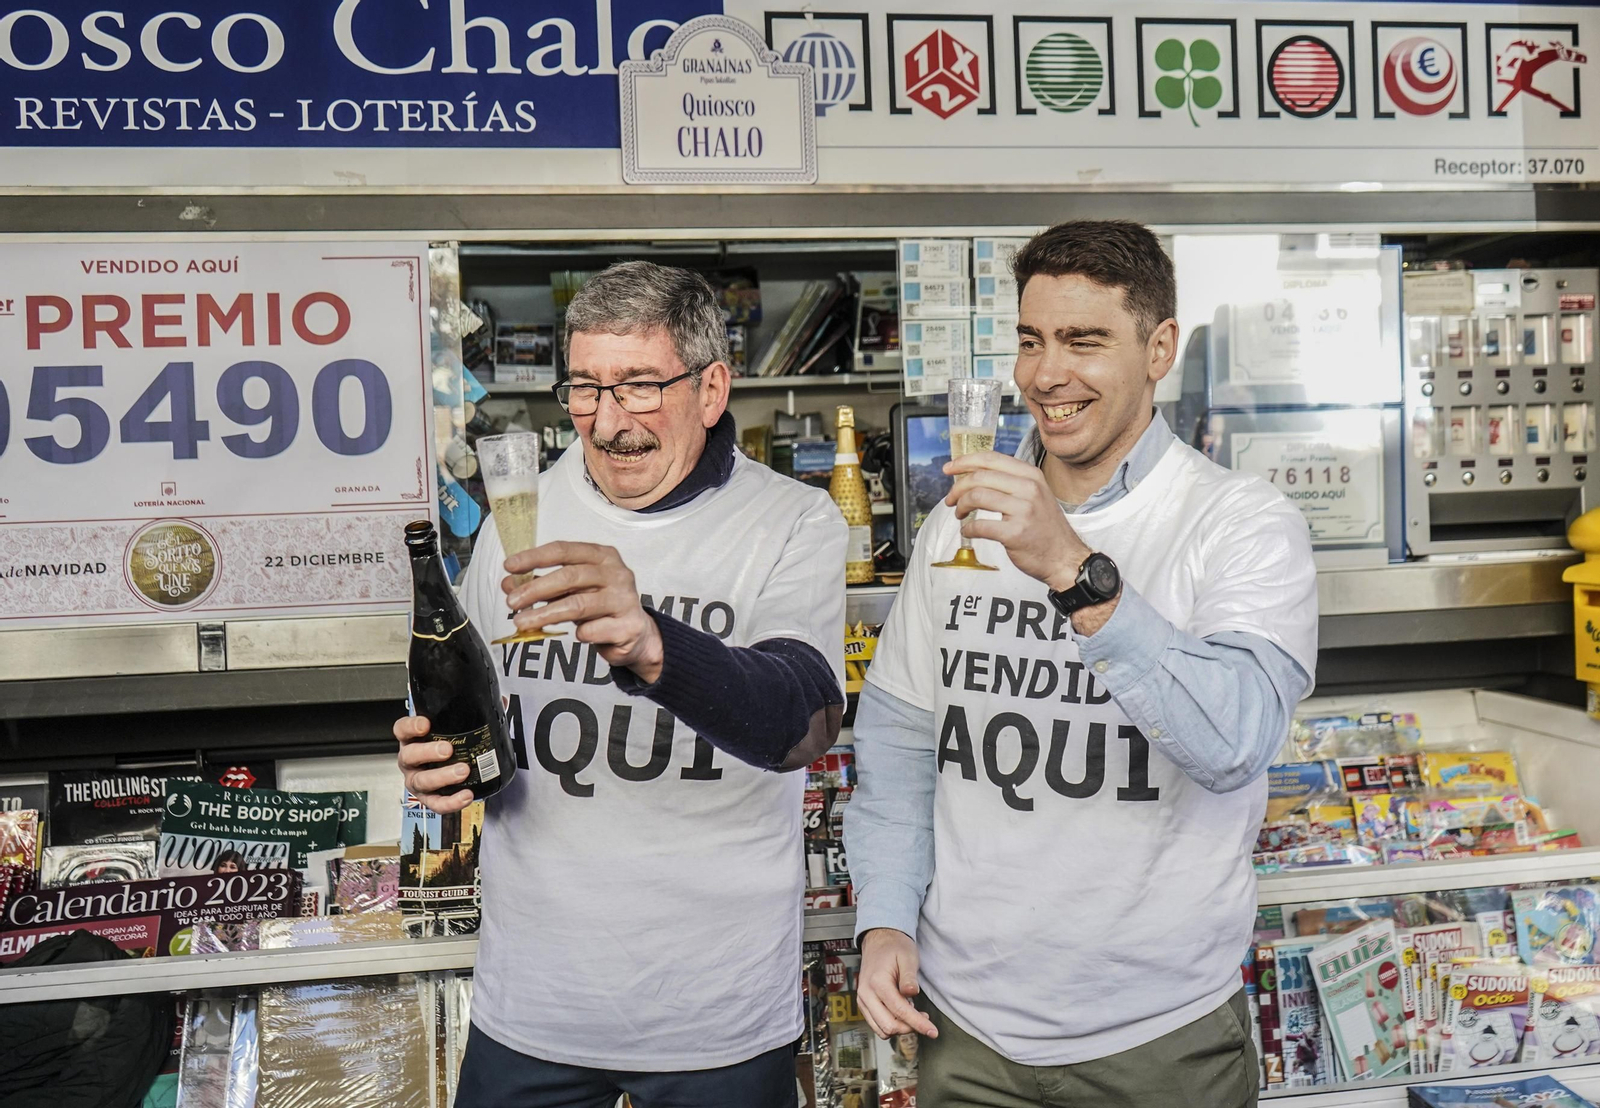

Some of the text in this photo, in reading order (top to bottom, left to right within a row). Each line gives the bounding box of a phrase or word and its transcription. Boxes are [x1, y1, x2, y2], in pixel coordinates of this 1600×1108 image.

[682, 57, 752, 74] GRANAÍNAS
[15, 97, 256, 131] REVISTAS
[297, 91, 537, 133] LOTERÍAS
[682, 93, 756, 121] Quiosco
[677, 126, 763, 159] CHALO
[1434, 158, 1585, 178] Receptor: 37.070
[80, 256, 239, 275] VENDIDO AQUÍ
[25, 291, 352, 350] PREMIO
[0, 357, 393, 466] 5490
[1267, 465, 1350, 486] 76118
[334, 485, 381, 494] GRANADA
[1321, 487, 1345, 501] AQUÍ
[134, 499, 205, 508] LOTERÍA NACIONAL
[144, 542, 202, 571] SORTEO
[264, 552, 386, 568] 22 DICIEMBRE
[94, 796, 151, 808] COLLECTION
[199, 801, 336, 823] THE BODY SHOP
[190, 821, 206, 831] Gel
[211, 822, 230, 833] bath
[233, 824, 259, 835] blend
[270, 827, 308, 838] Champú
[9, 872, 290, 926] Calendario 2023
[402, 888, 469, 898] TOURIST GUIDE
[174, 903, 283, 918] IDEAS PARA DISFRUTAR DE
[178, 917, 191, 925] TU
[193, 916, 216, 924] CASA
[218, 914, 243, 922] TODO
[257, 910, 278, 919] AÑO
[102, 926, 127, 936] GRAN
[127, 924, 147, 933] AÑO
[1414, 930, 1461, 952] SUDOKU
[1468, 976, 1527, 993] SUDOKU
